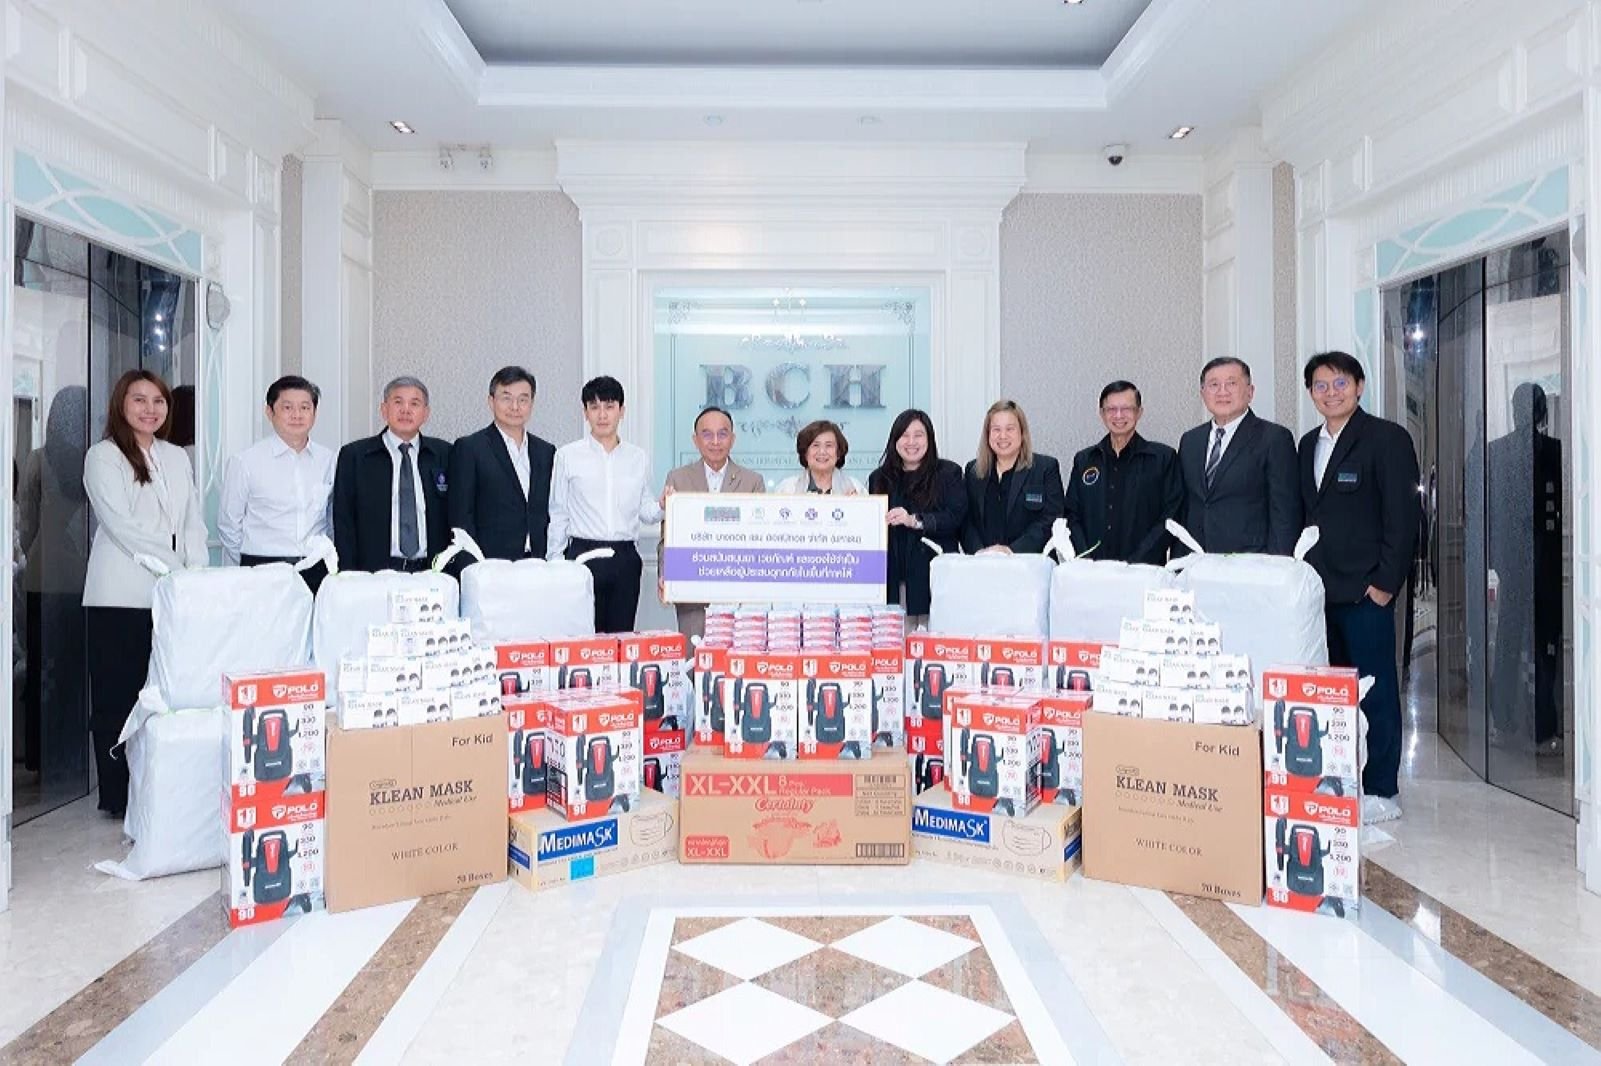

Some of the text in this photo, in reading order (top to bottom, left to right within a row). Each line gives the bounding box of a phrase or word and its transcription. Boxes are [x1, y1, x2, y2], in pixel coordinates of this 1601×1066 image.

[699, 362, 887, 409] BCH
[768, 664, 794, 672] POLO
[841, 663, 866, 672] POLO
[1317, 686, 1349, 697] POLO
[452, 733, 494, 747] For Kid
[1195, 741, 1240, 756] For Kid
[370, 779, 474, 806] KLEAN MASK
[690, 775, 777, 795] XL-XXL
[1116, 775, 1219, 802] KLEAN MASK
[755, 798, 814, 813] Certainty
[1319, 806, 1352, 817] POLO
[391, 842, 459, 861] WHITE COLOR
[687, 847, 728, 857] XL-XXL
[1135, 837, 1203, 857] WHITE COLOR
